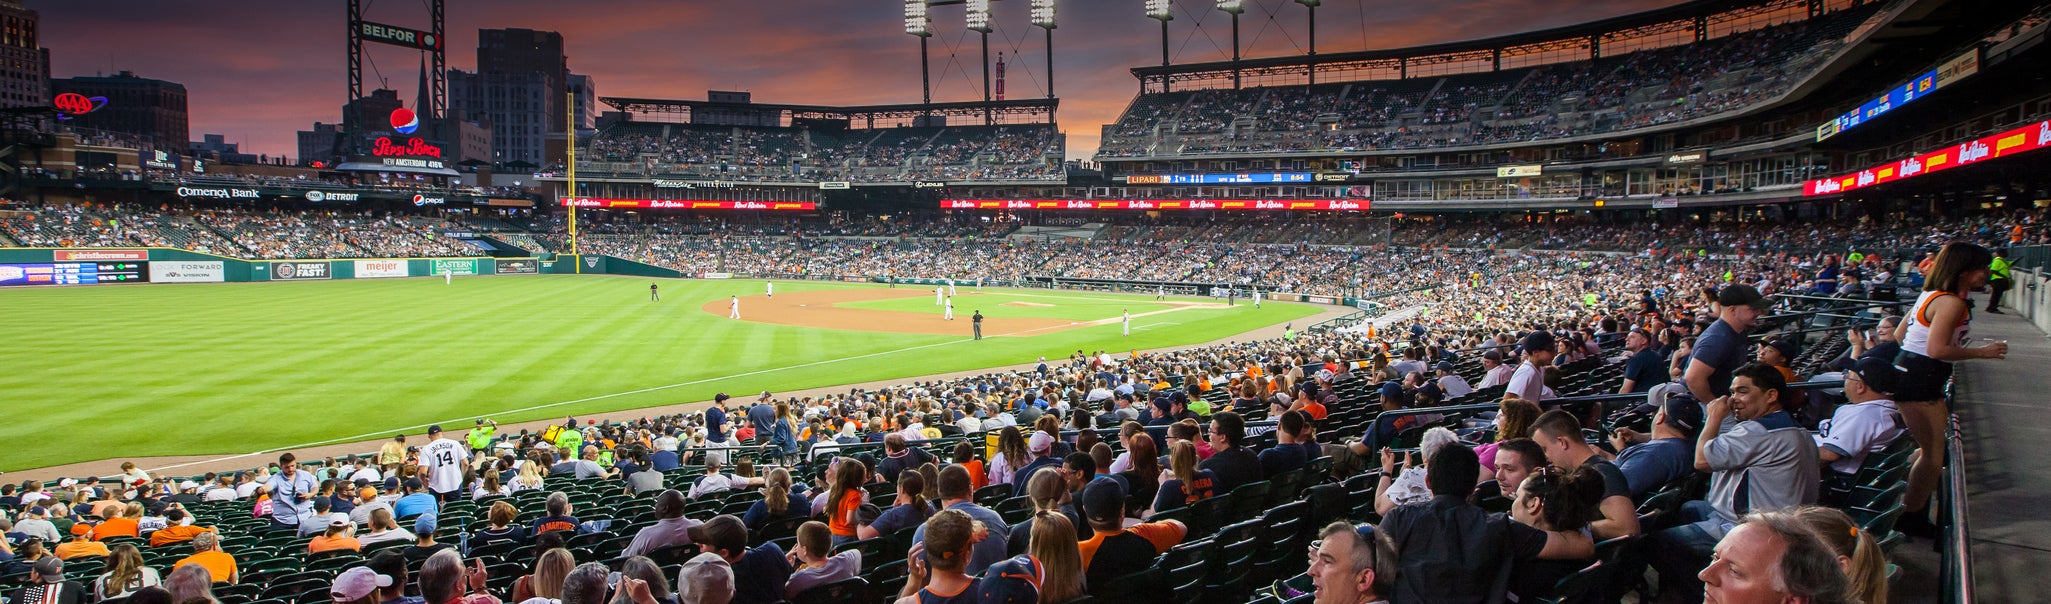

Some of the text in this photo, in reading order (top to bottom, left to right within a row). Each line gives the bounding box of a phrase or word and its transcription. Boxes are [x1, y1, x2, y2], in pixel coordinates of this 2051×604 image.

[362, 24, 415, 43] BELFOR
[56, 93, 91, 114] AAA
[1958, 140, 1989, 164] Red Robin
[383, 158, 395, 167] NEW
[395, 159, 427, 168] AMSTERDAM
[1131, 175, 1158, 184] LIPARI
[231, 188, 260, 198] Bank
[651, 200, 684, 208] Red Robin
[734, 201, 767, 209] Red Robin
[952, 200, 975, 208] Red Robin
[1008, 200, 1032, 208] Red Robin
[1067, 200, 1092, 208] Red Robin
[1129, 200, 1153, 208] Red Robin
[1189, 200, 1216, 208] Red Robin
[1256, 200, 1284, 208] Red Robin
[1329, 200, 1359, 209] Red Robin
[366, 261, 398, 272] meijer
[436, 260, 473, 269] EASTERN
[296, 269, 325, 277] FAST!
[430, 442, 453, 454] JACKSON
[436, 451, 454, 468] 14
